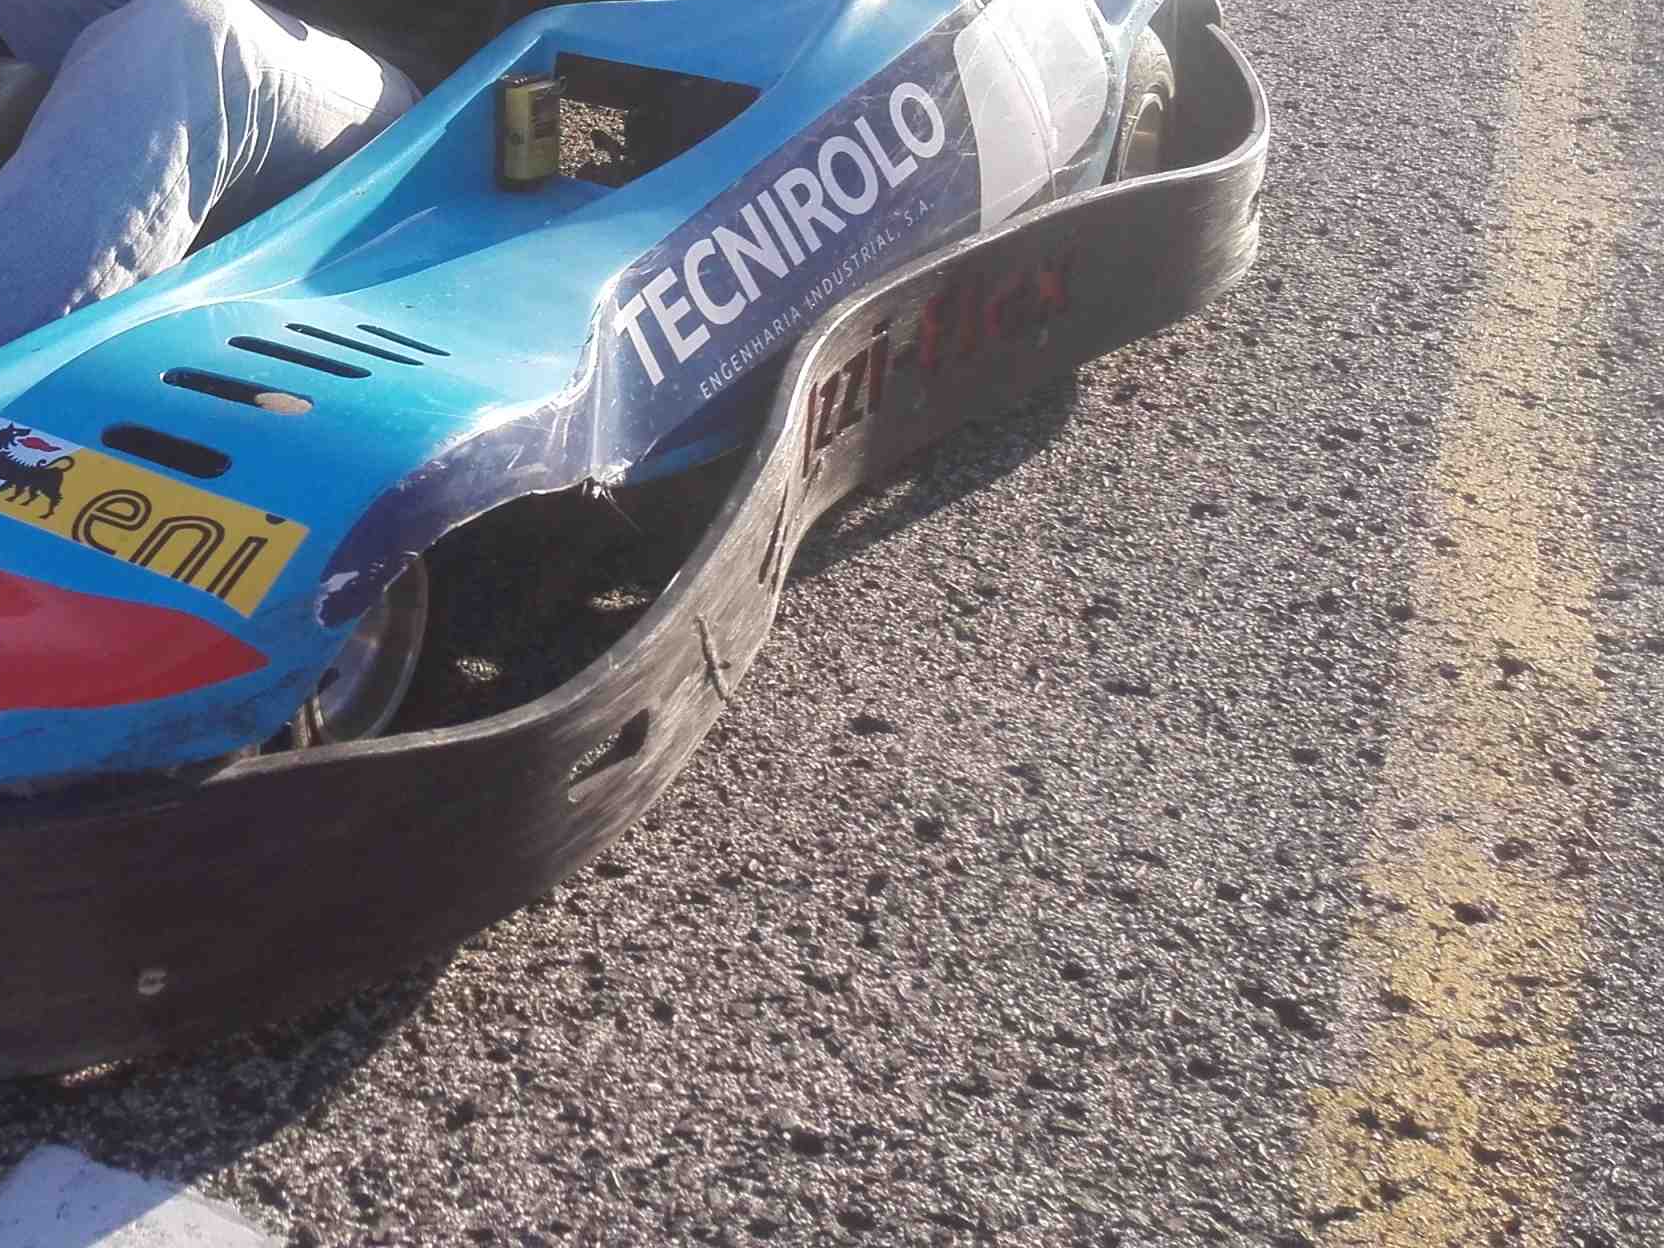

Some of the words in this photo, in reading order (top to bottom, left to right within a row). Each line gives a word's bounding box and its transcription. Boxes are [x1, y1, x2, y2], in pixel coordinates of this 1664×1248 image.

[615, 81, 947, 386] TECNIROLO
[698, 308, 802, 401] ENGENHARIA
[72, 488, 287, 600] eni
